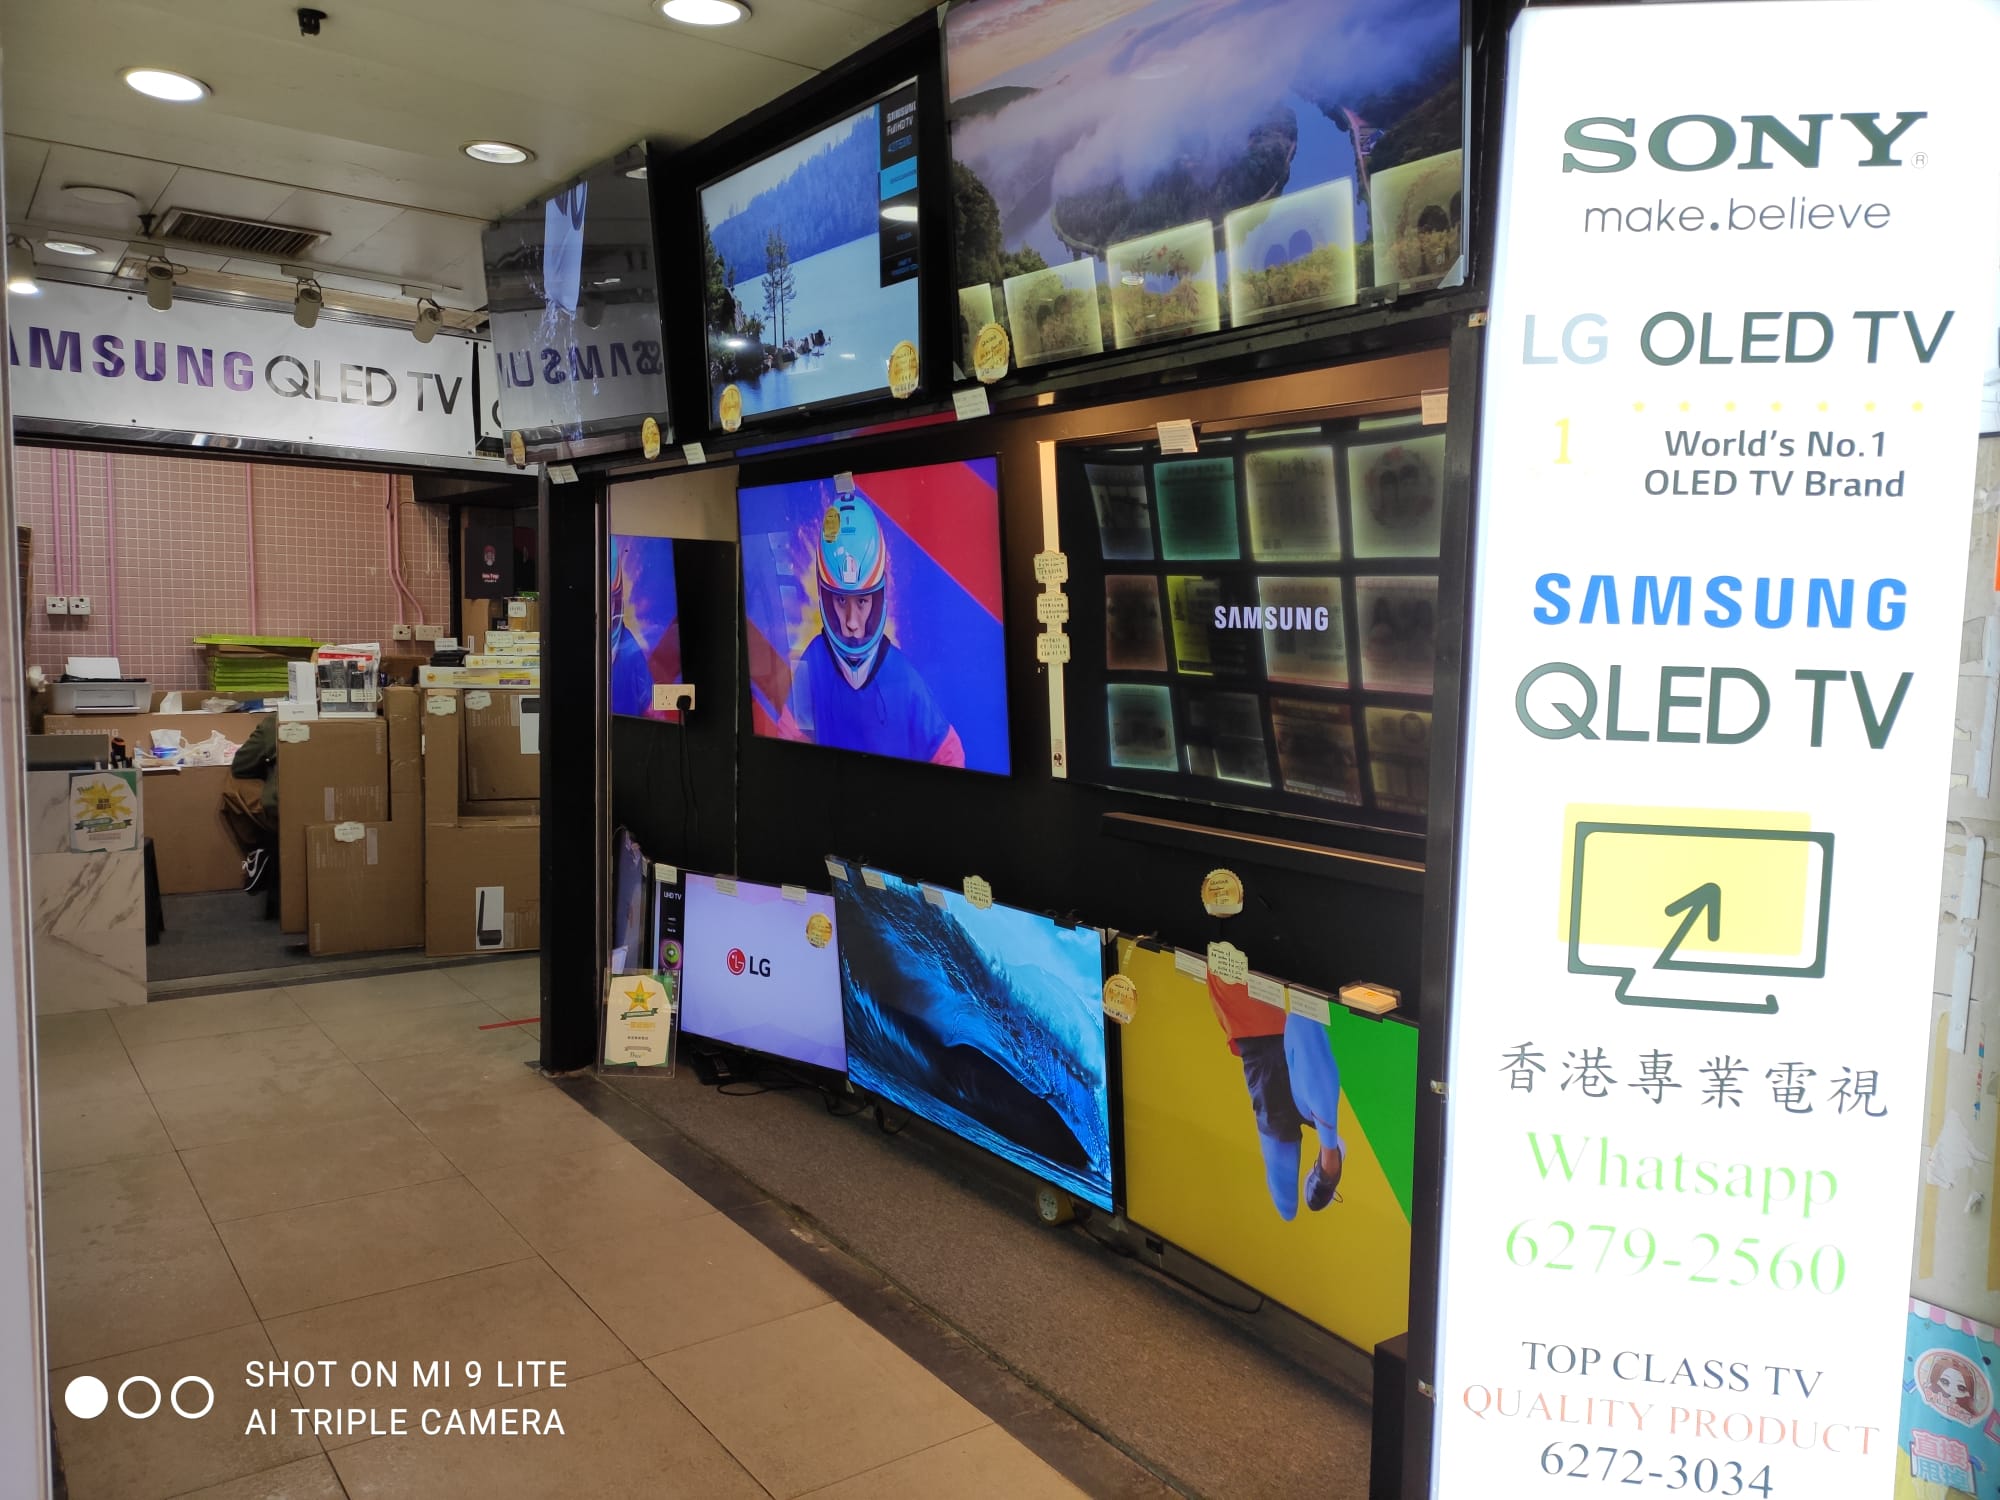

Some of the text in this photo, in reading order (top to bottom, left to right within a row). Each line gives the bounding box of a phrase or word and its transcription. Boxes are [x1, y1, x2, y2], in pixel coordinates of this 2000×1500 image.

[1562, 111, 1928, 173] SONY
[1585, 196, 1891, 232] make.believe
[1522, 310, 1955, 367] LG OLED TV
[264, 354, 397, 407] QLED
[407, 370, 463, 415] TV
[1553, 417, 1573, 465] 1
[1664, 430, 1886, 459] World's No.1
[1644, 469, 1906, 498] OLED TV Brand
[1214, 605, 1329, 631] SAMSUNG
[1533, 572, 1907, 631] SAMSUNG
[1515, 661, 1914, 750] QLED TV
[749, 956, 771, 977] LG
[1499, 1041, 1889, 1118] 香港專業電視
[1526, 1132, 1838, 1218] Whatsapp
[1505, 1218, 1846, 1295] 6279-2560
[1522, 1341, 1824, 1399] TOP CLASS TV
[1463, 1384, 1654, 1431] QUALITY
[1670, 1406, 1880, 1455] PRODUCT
[1541, 1440, 1774, 1499] 6272-3034
